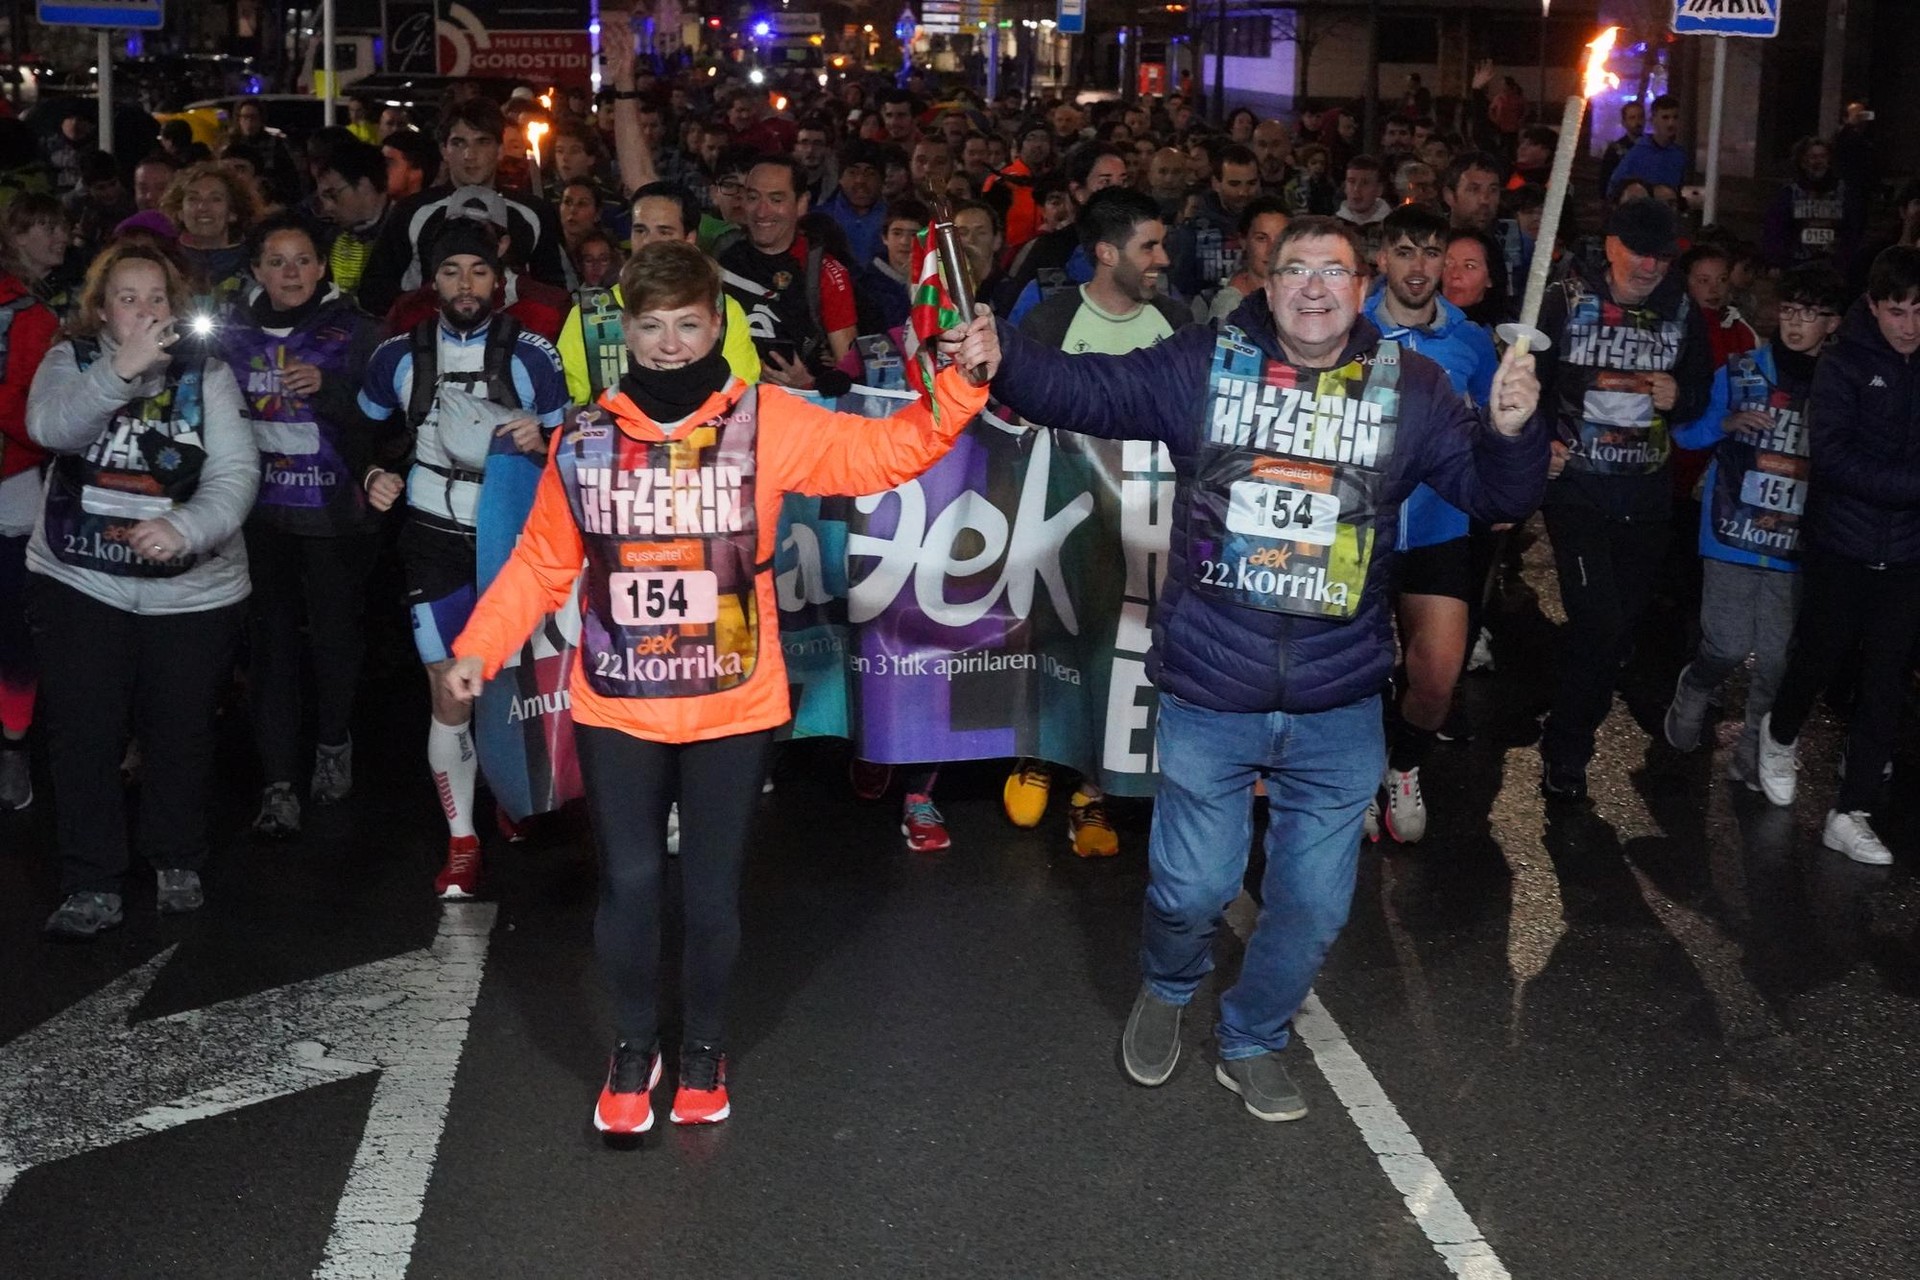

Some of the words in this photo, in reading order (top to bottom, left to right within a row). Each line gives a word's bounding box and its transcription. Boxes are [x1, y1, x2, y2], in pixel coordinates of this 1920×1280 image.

[495, 37, 573, 48] MUEBLES
[472, 53, 587, 69] GOROSTIDI
[1210, 377, 1383, 467] HITZEKIN
[264, 462, 336, 487] korrika
[577, 467, 742, 534] HITZEKIN
[1255, 487, 1313, 529] 154
[1760, 478, 1797, 509] 151
[626, 548, 682, 562] euskaltel
[1249, 544, 1293, 570] aek
[627, 579, 688, 618] 154
[636, 629, 678, 656] aek
[934, 652, 1037, 683] apirilaren
